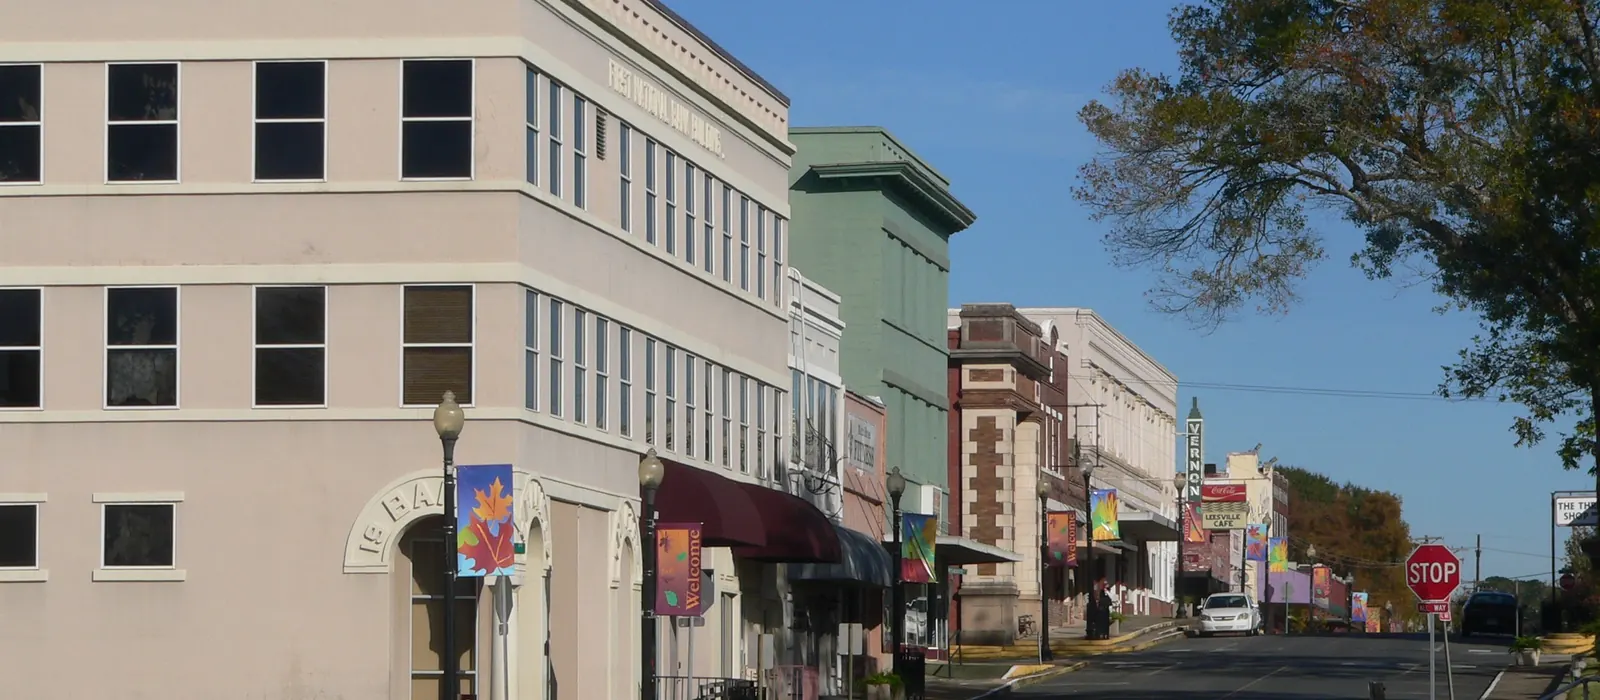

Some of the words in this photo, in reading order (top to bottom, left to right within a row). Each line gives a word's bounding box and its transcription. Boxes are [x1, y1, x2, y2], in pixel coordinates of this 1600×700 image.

[1189, 423, 1200, 496] VERNON
[1558, 502, 1574, 510] THE
[1205, 513, 1240, 521] LEESVILLE
[1563, 511, 1589, 520] SHOP
[1067, 513, 1076, 562] Welcome
[686, 529, 700, 611] Welcome
[1409, 562, 1457, 584] STOP
[1433, 604, 1447, 612] WAY
